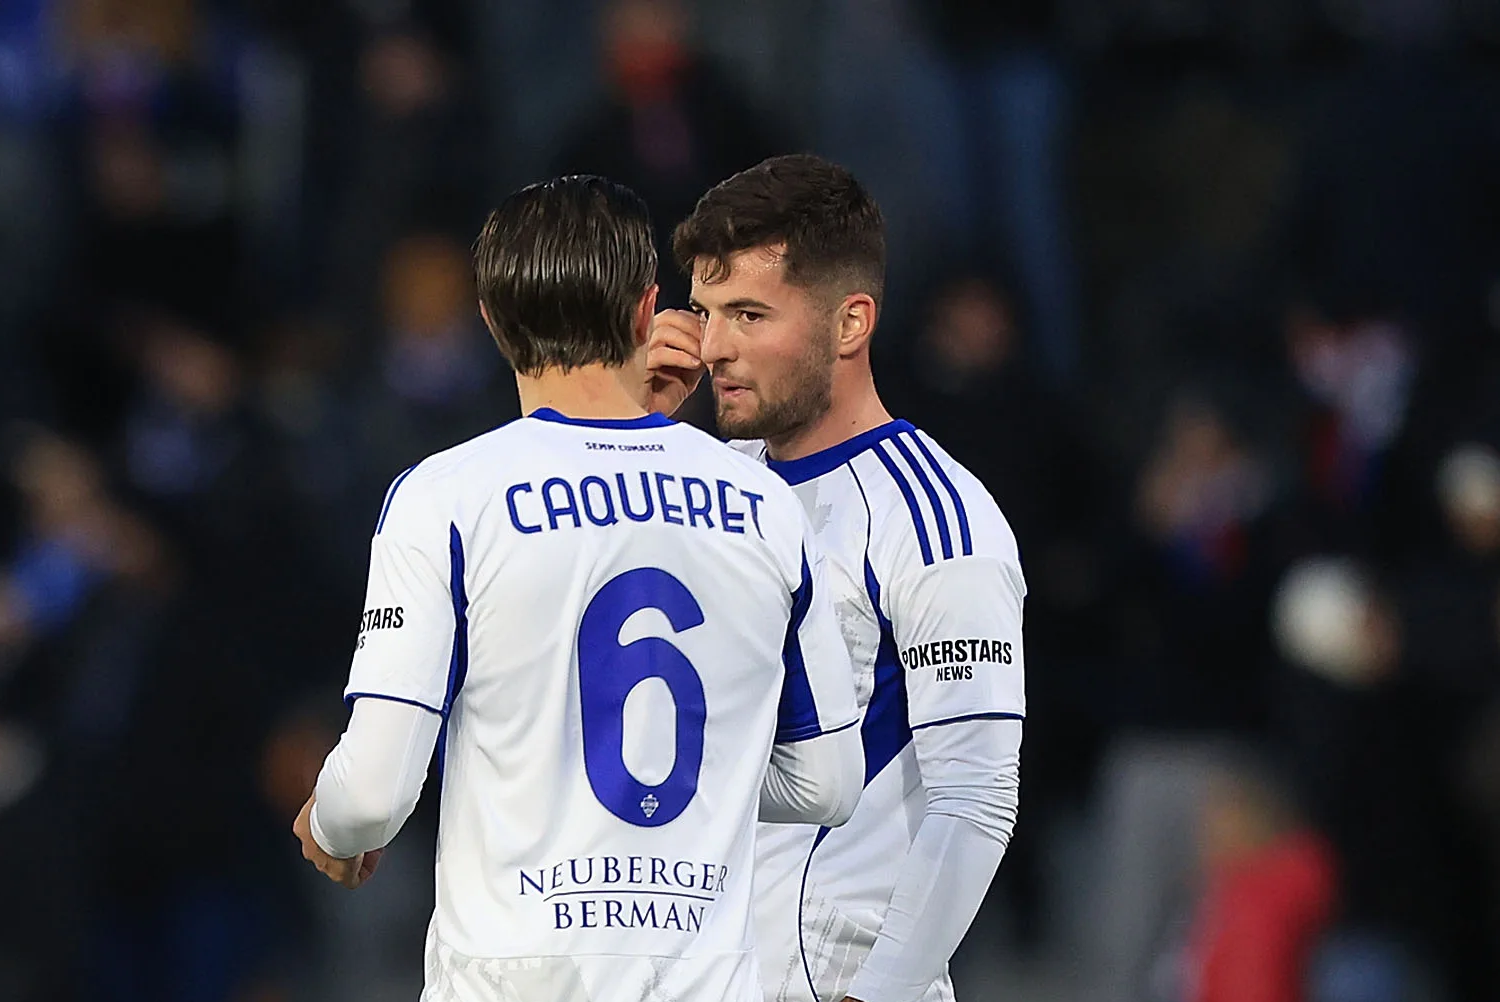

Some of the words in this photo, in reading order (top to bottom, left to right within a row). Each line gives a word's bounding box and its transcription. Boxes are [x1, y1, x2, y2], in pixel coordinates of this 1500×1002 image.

[505, 472, 766, 541] CAQUERET
[901, 639, 1013, 671] POKERSTARS
[935, 665, 974, 682] NEWS
[577, 566, 707, 828] 6
[518, 856, 729, 896] NEUBERGER
[553, 899, 706, 934] BERMAN
